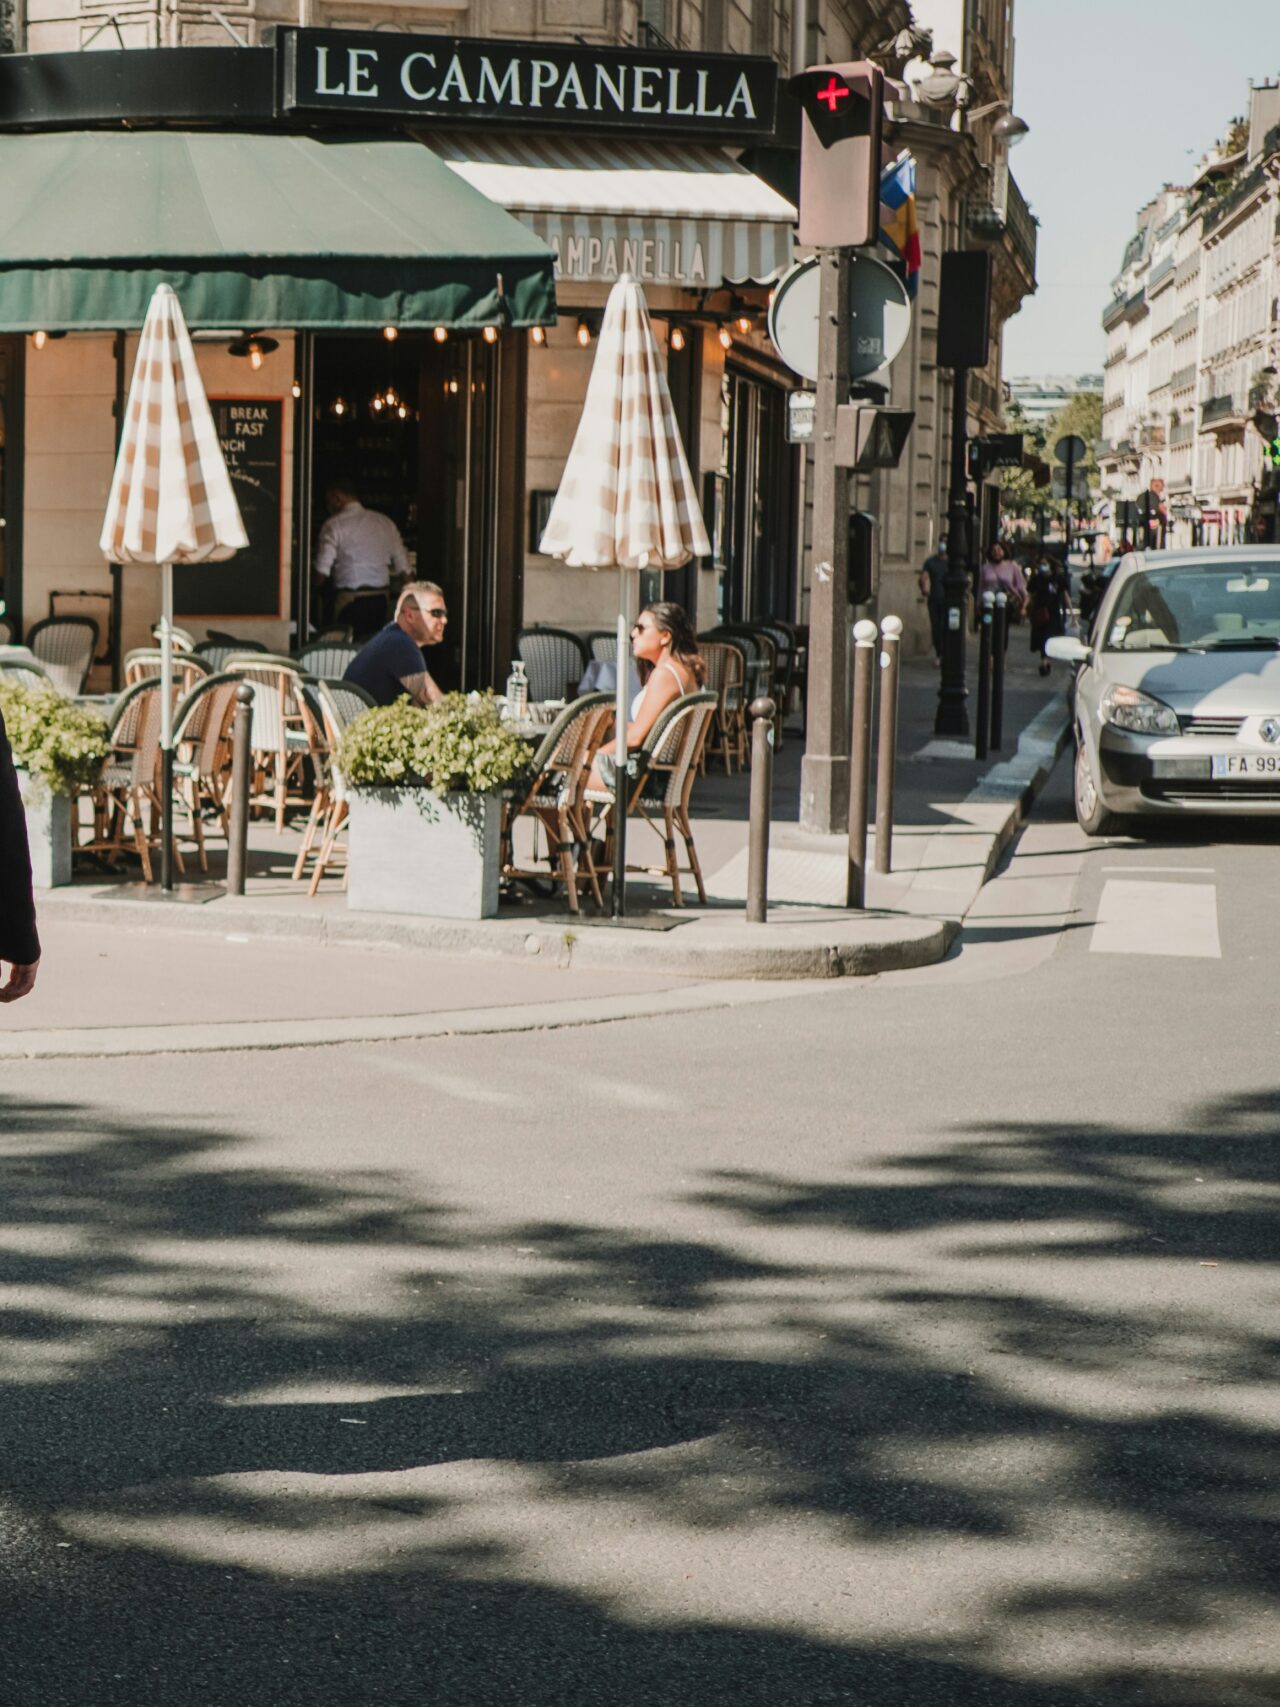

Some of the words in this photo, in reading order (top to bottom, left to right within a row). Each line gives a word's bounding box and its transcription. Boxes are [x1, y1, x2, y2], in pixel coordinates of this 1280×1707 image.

[314, 46, 379, 98] LE
[400, 51, 757, 119] CAMPANELLA
[538, 236, 705, 281] AMPANELLA
[230, 407, 269, 420] BREAK
[235, 422, 265, 436] FAST
[221, 440, 246, 451] NCH
